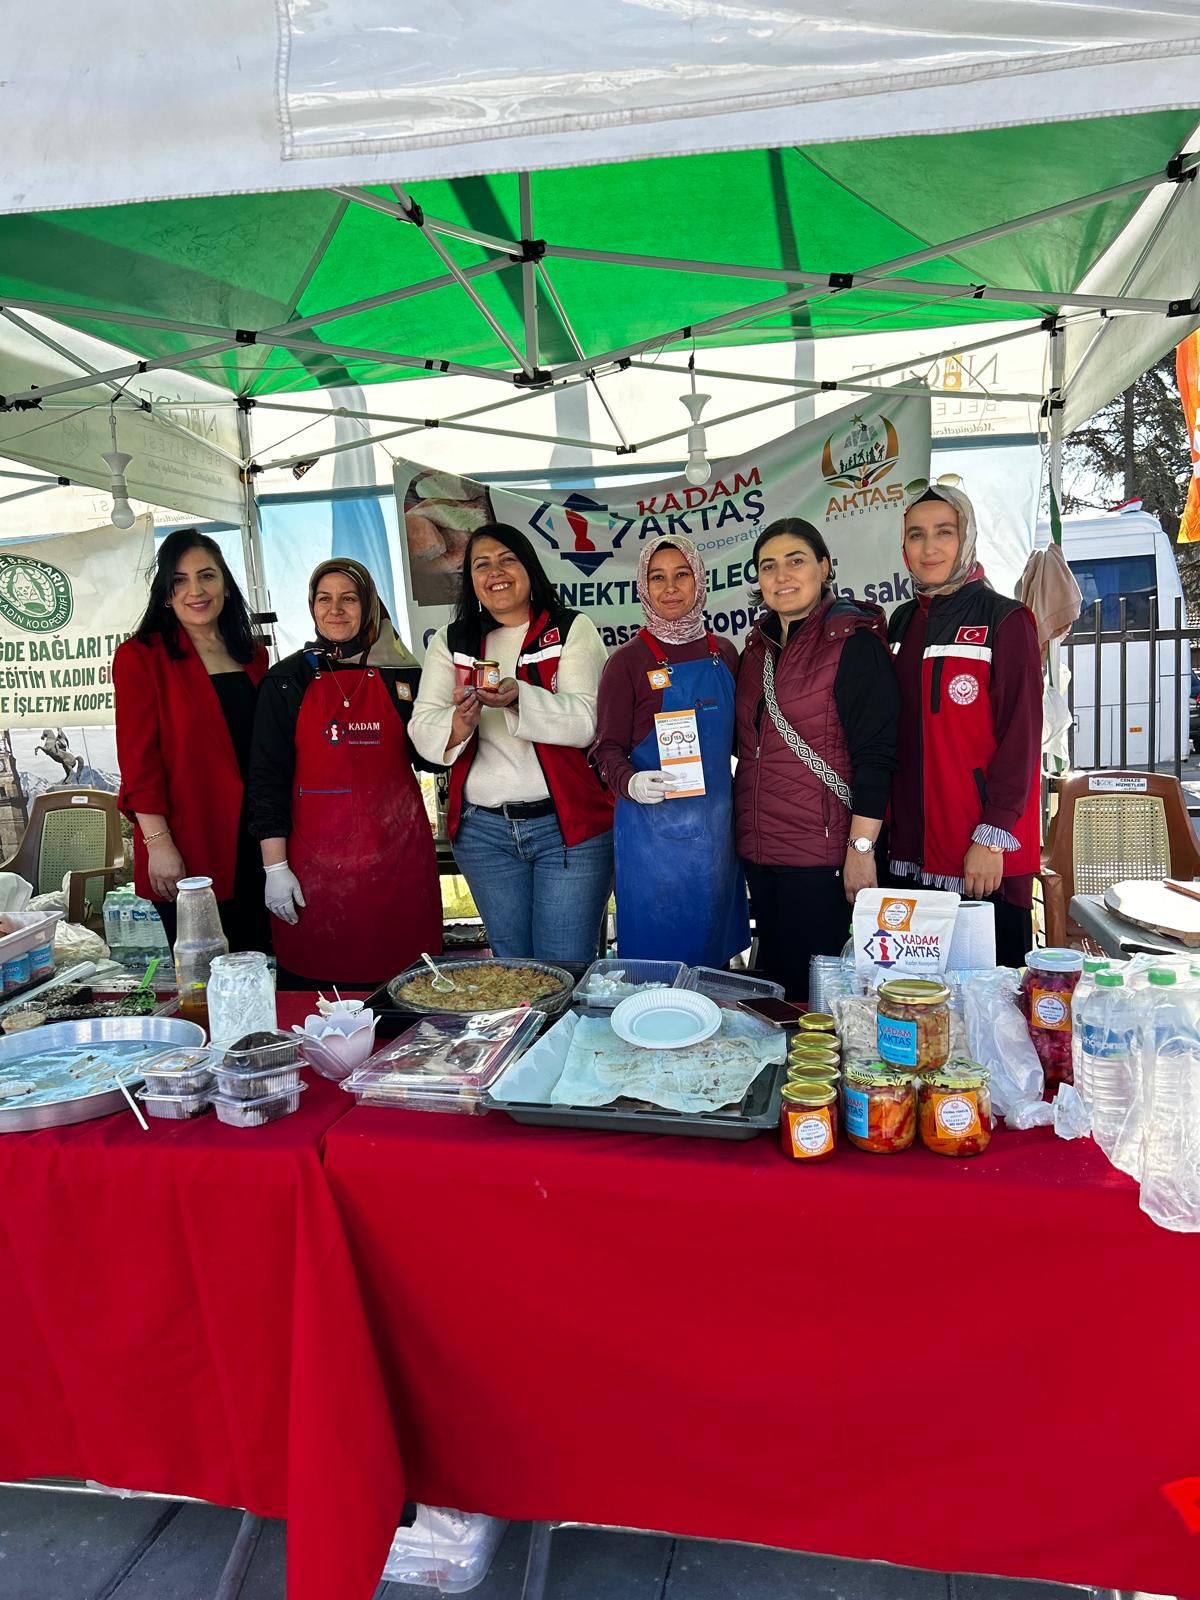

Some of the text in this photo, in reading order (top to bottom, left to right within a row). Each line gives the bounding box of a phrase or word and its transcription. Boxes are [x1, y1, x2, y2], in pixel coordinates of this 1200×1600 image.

[636, 466, 762, 516] KADAM
[826, 482, 904, 515] AKTAŞ
[638, 489, 765, 540] AKTAŞ
[693, 523, 767, 552] ooperatif
[0, 601, 25, 624] ADIN
[28, 634, 102, 663] BAĞLARI
[50, 667, 96, 689] KADIN
[13, 692, 71, 717] İŞLETME
[348, 722, 380, 731] KADAM
[901, 934, 939, 946] KADAM
[904, 945, 941, 961] AKTAŞ
